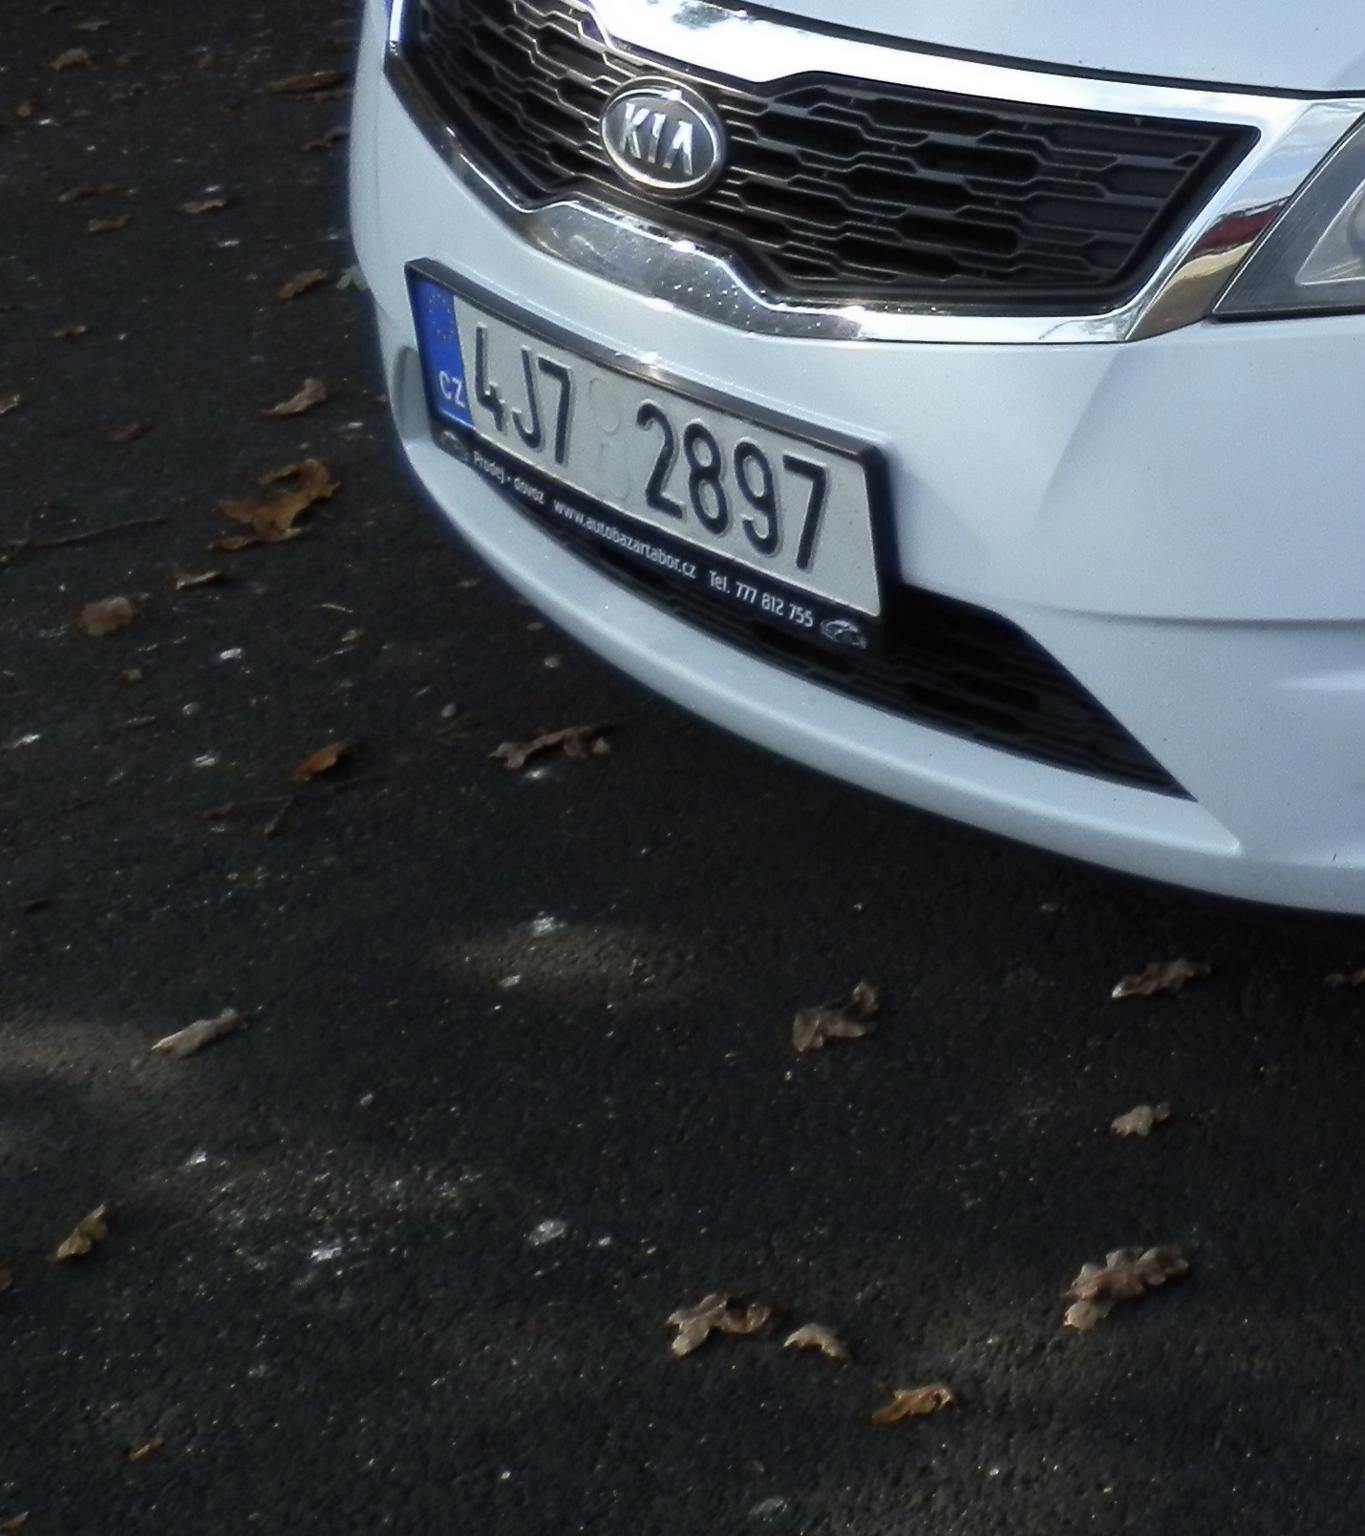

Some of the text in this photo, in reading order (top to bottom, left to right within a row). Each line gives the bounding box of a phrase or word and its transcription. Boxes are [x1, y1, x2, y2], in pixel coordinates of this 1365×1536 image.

[619, 102, 693, 176] KIA
[438, 369, 466, 409] CZ
[475, 320, 827, 570] 4J7 2897
[514, 476, 545, 505] dovoz
[554, 499, 697, 579] www.autobazartabor.cz
[709, 569, 731, 594] Tel.
[736, 581, 757, 604] 777
[761, 593, 784, 616] 812
[789, 603, 814, 628] 755
